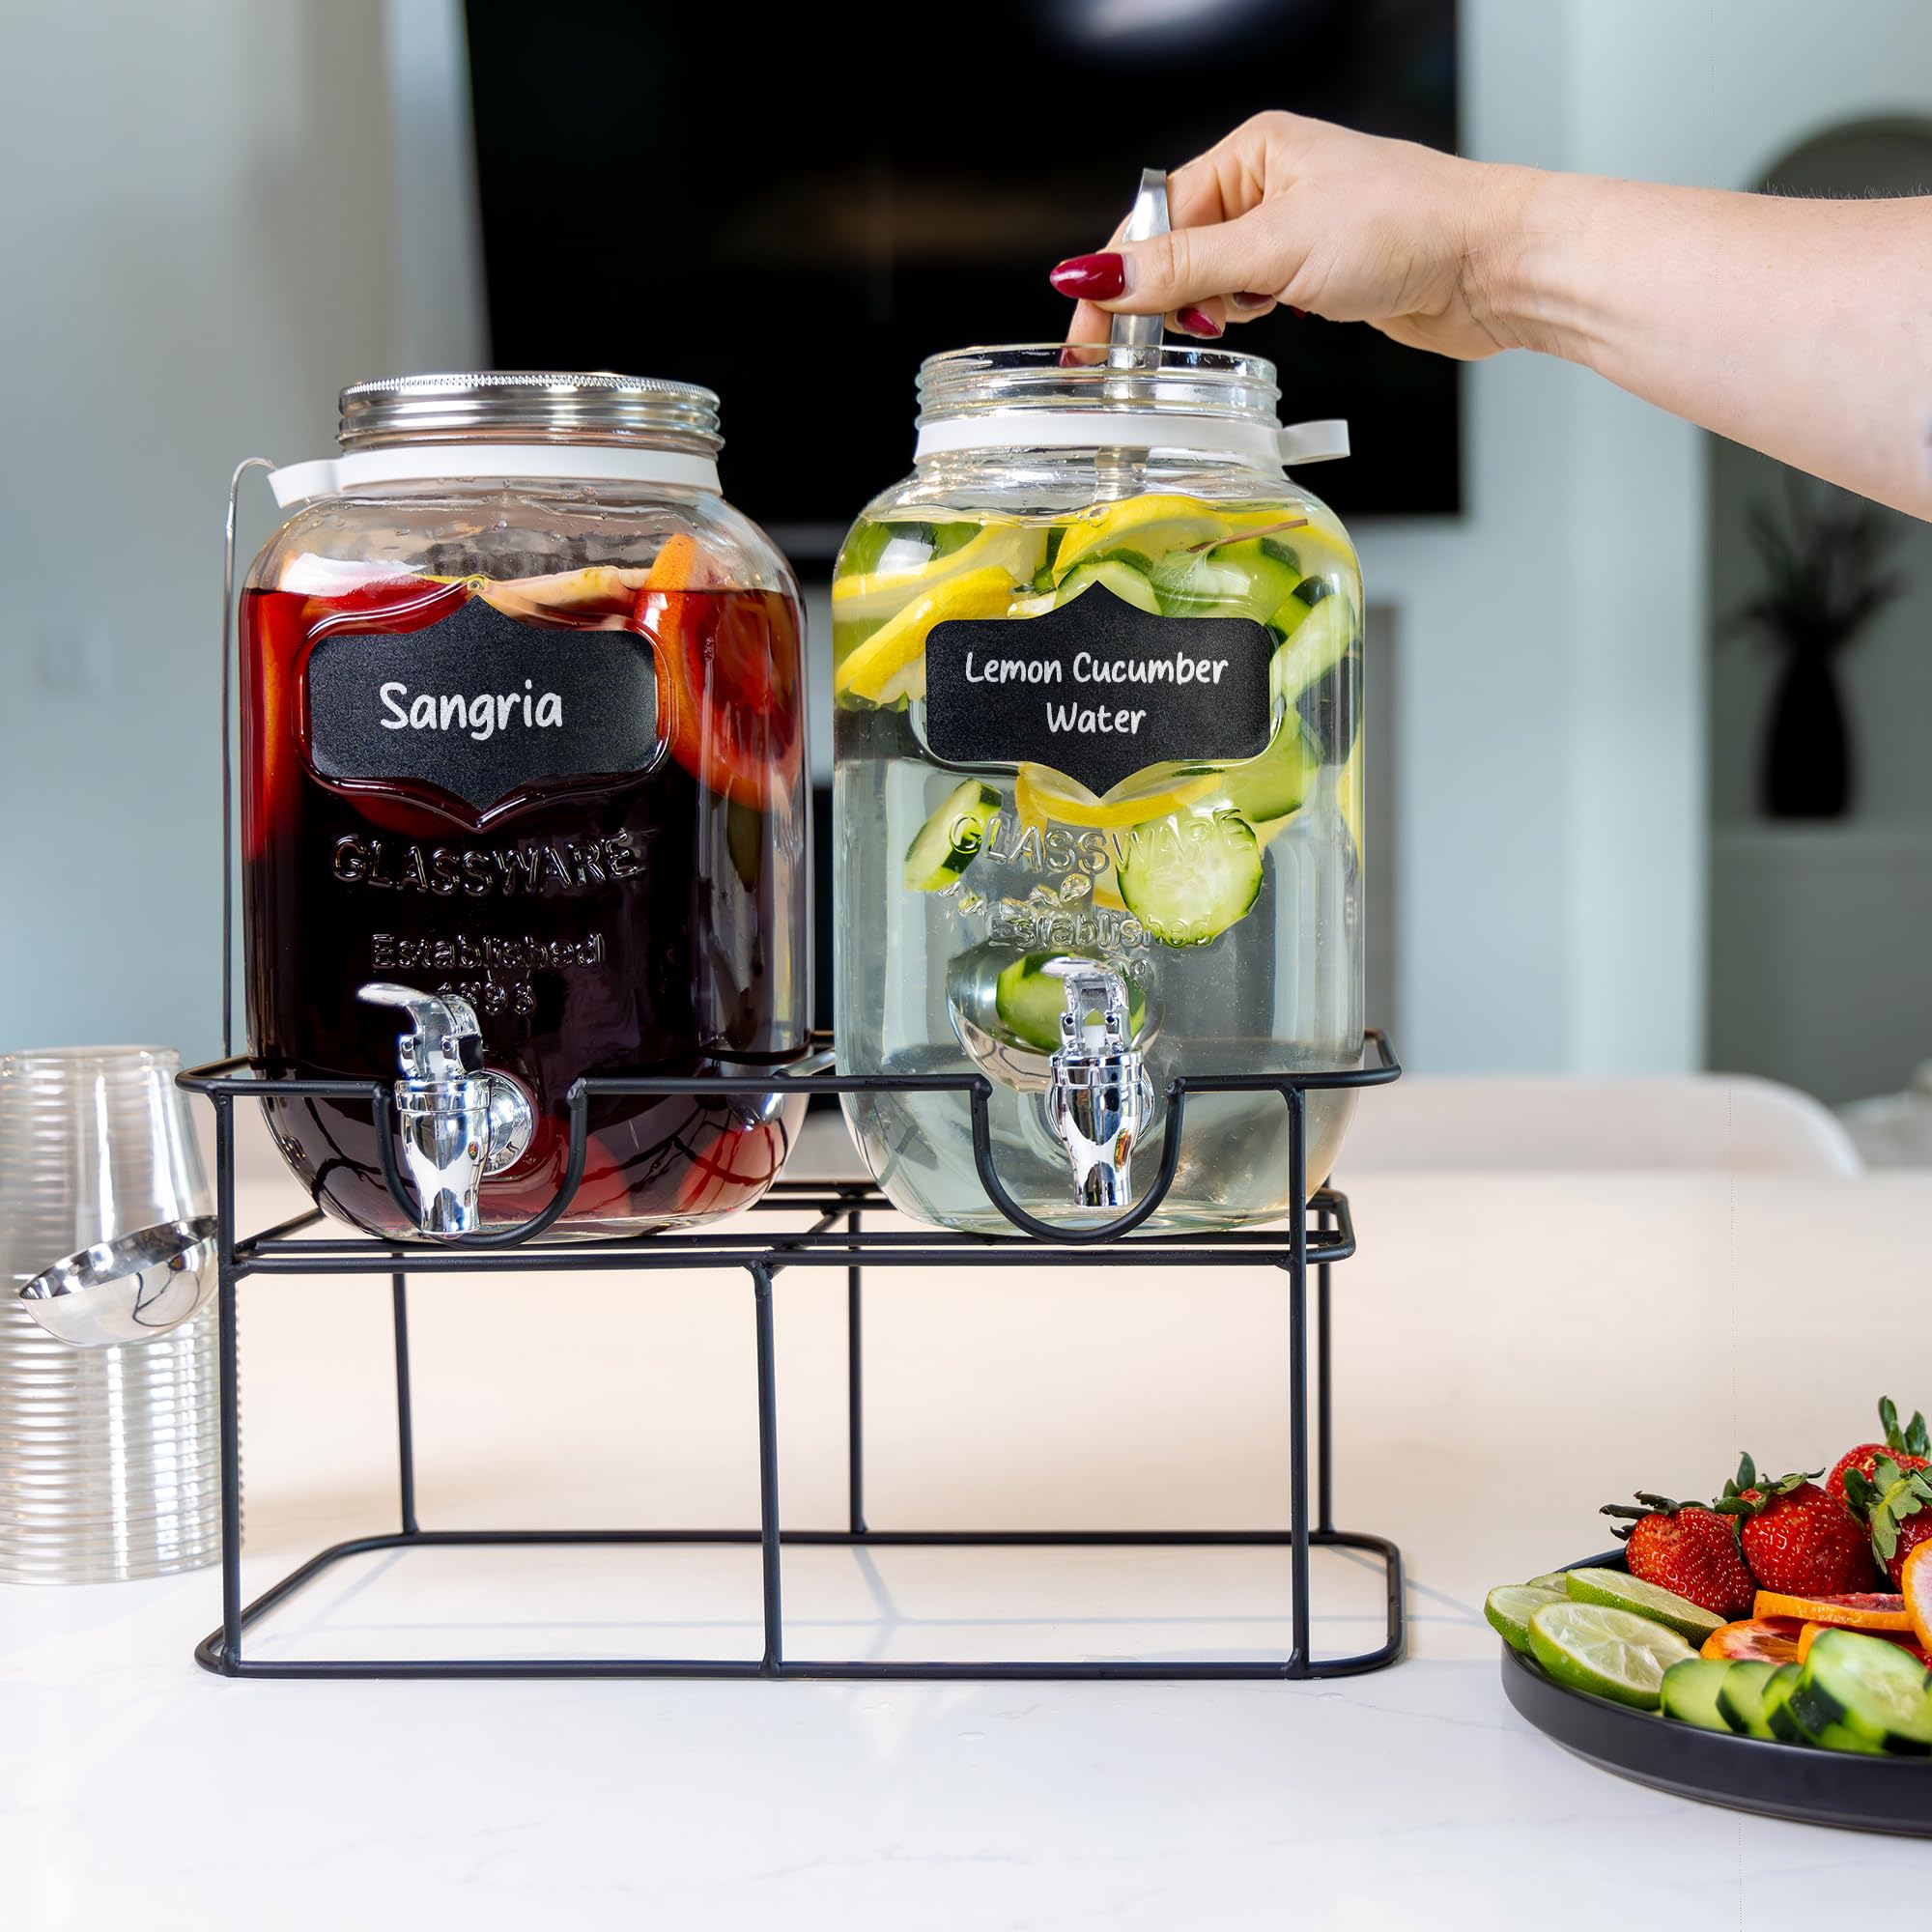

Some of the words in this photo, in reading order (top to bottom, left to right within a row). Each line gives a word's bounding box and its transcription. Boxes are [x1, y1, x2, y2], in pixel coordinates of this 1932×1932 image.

[965, 651, 1063, 685] Lemon
[1072, 651, 1229, 685] Cucumber
[379, 678, 563, 741] Sangria
[1045, 701, 1147, 734] Water
[332, 828, 645, 896] GLASSWARE
[371, 931, 606, 968] Established
